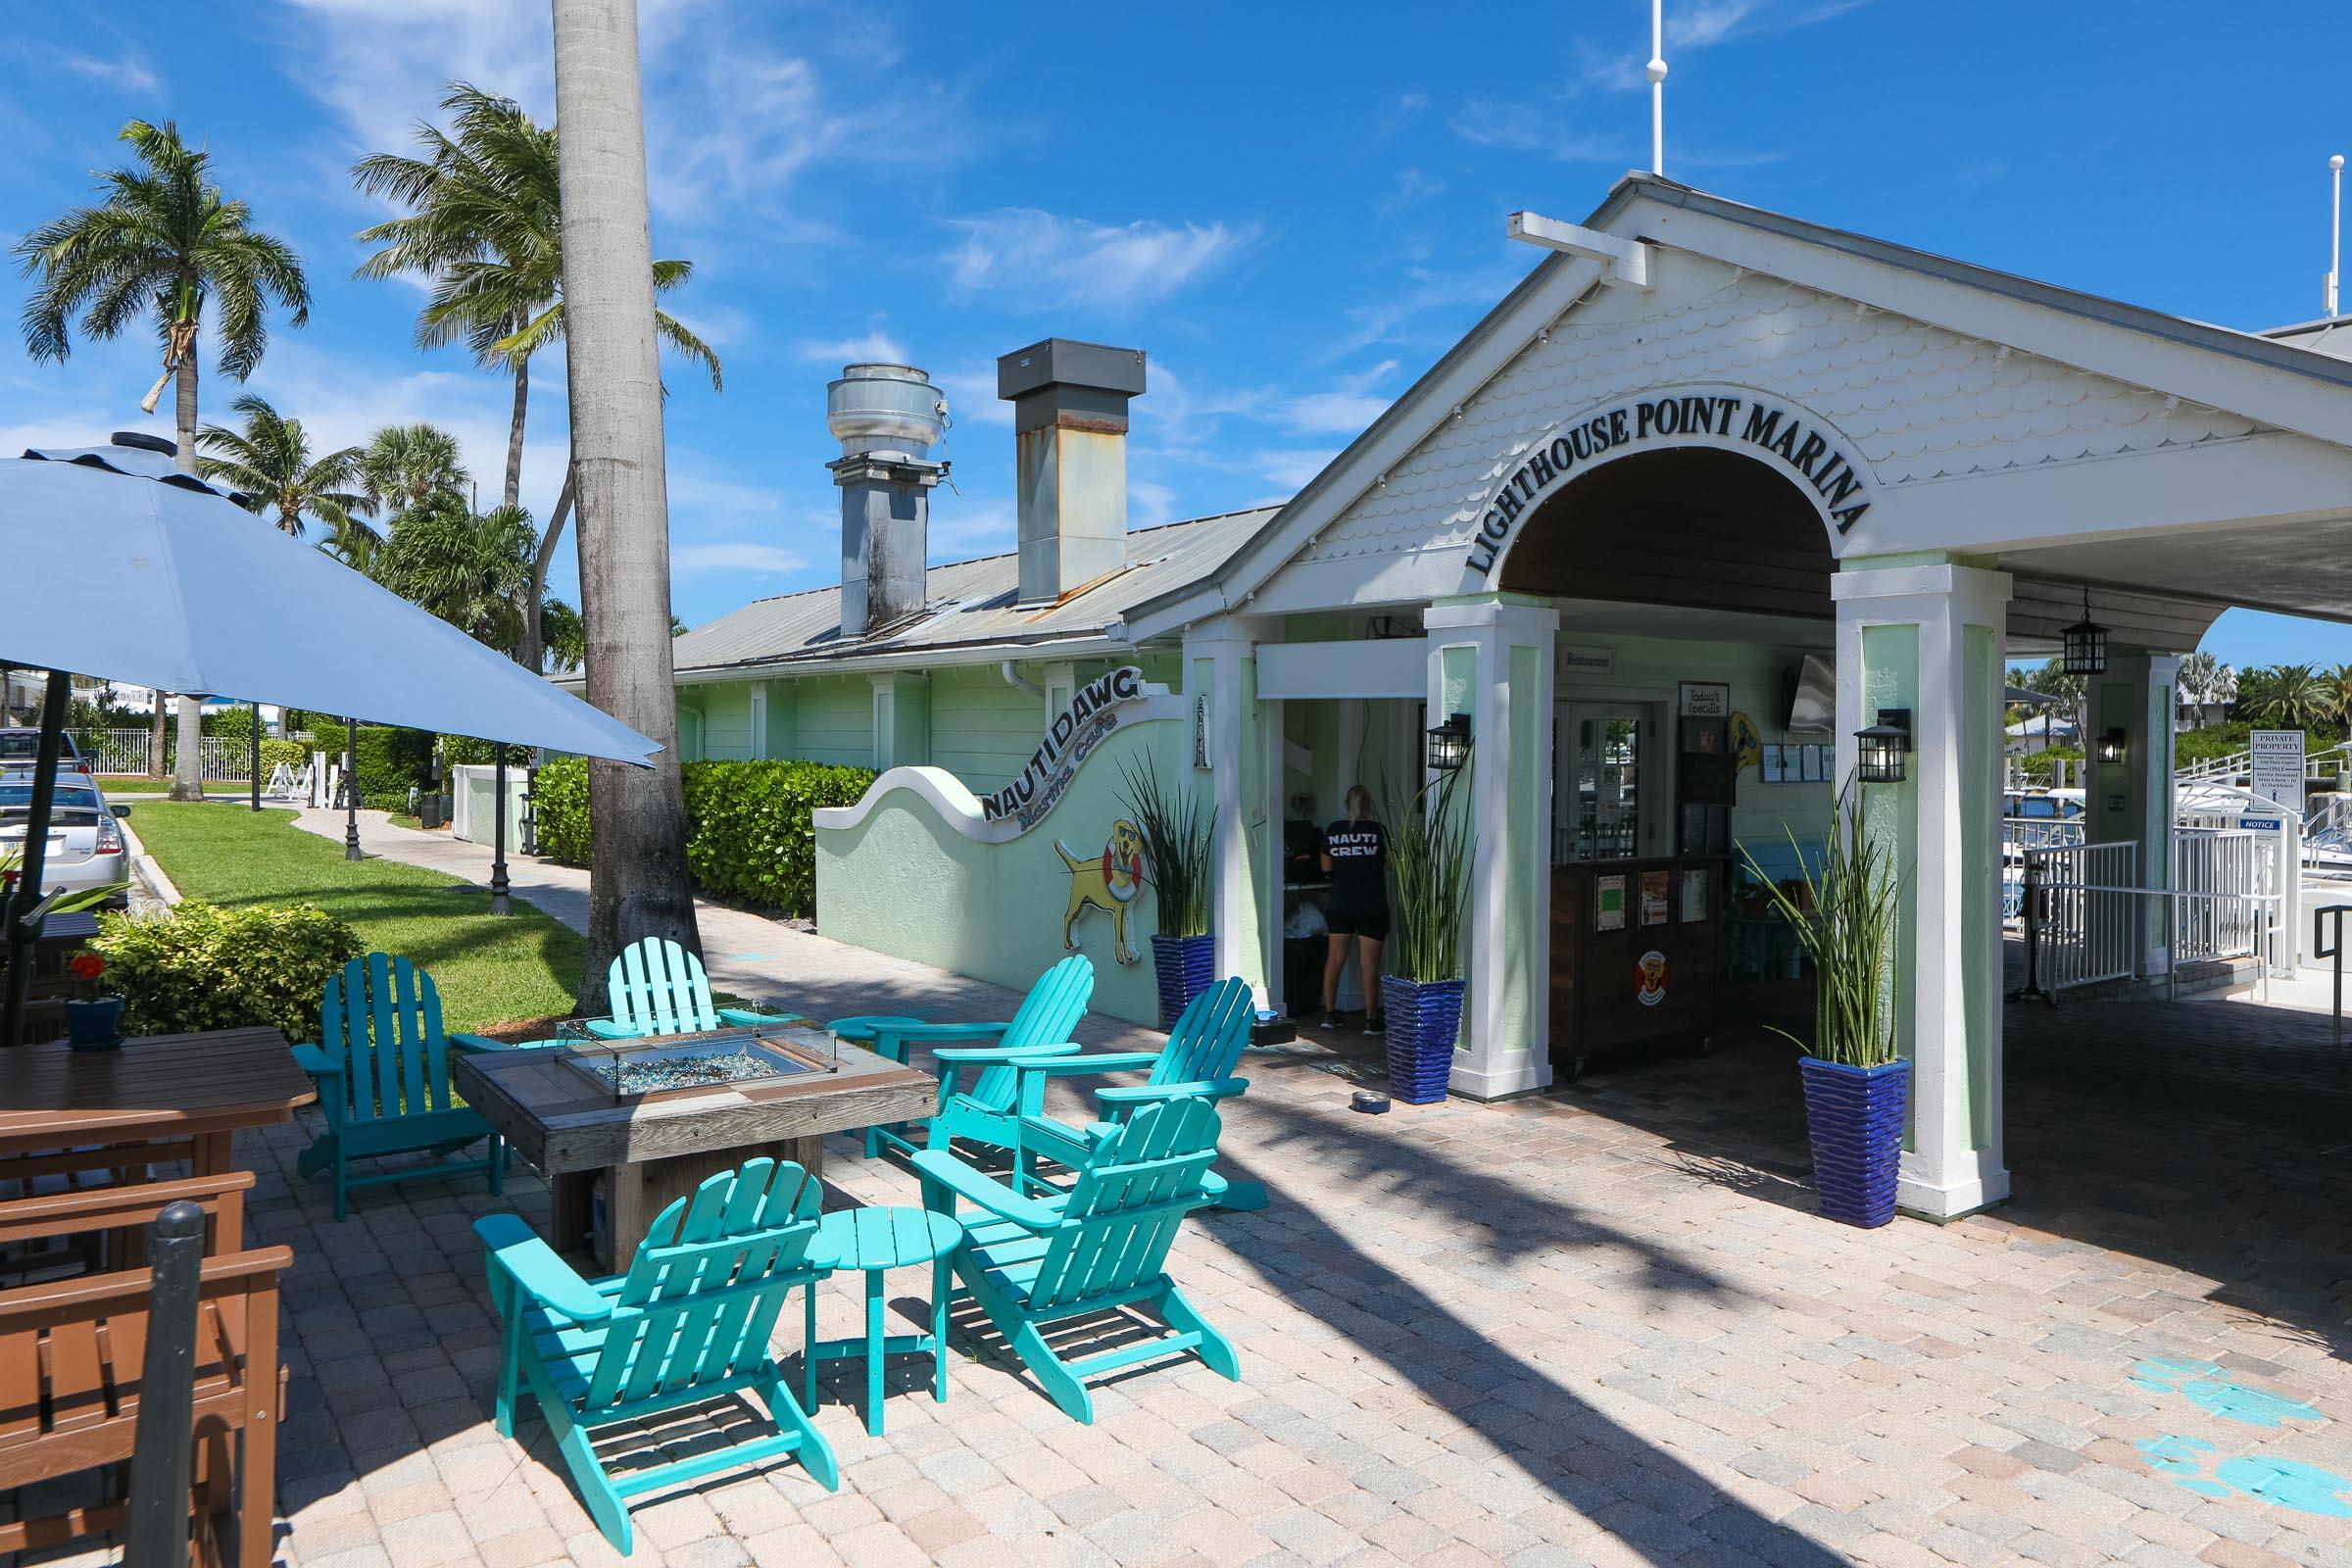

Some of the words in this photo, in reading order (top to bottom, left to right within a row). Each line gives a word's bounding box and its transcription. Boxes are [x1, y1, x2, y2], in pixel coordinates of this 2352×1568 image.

[1464, 409, 1631, 576] LIGHTHOUSE
[1635, 396, 1741, 439] POINT
[1741, 403, 1871, 537] MARINA
[1567, 651, 1610, 667] Restaurant
[1690, 689, 1721, 704] Today's
[1688, 702, 1722, 714] Specials
[982, 667, 1141, 822] NAUTIDAWG
[1018, 764, 1075, 832] Marina
[2245, 820, 2275, 829] NOTICE
[1327, 833, 1377, 845] NAUTI
[1329, 846, 1378, 857] CREW
